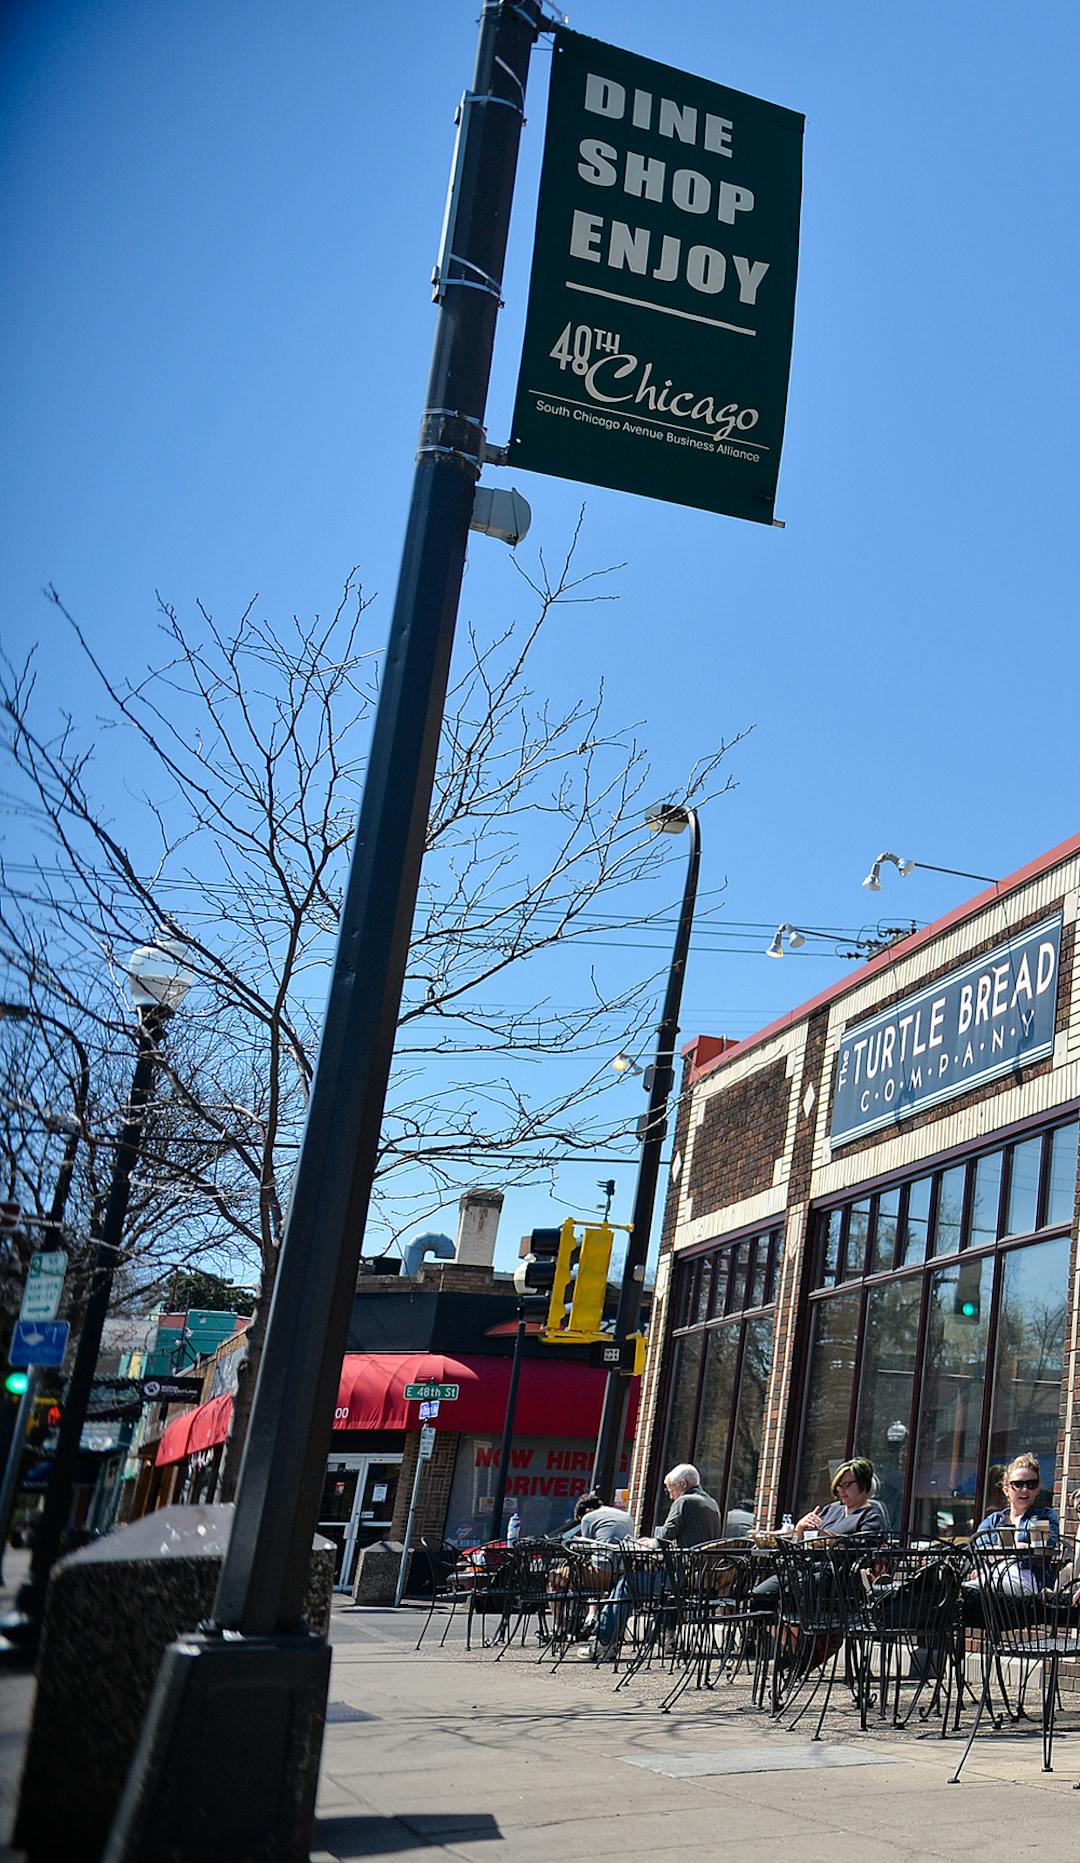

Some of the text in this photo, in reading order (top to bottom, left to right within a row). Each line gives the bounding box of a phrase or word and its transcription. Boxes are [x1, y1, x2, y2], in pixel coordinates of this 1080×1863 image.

[584, 72, 733, 159] DINE
[577, 138, 755, 225] SHOP
[568, 209, 770, 306] ENJOY
[535, 400, 761, 463] South Chicago Avenue Business Alliance
[584, 353, 760, 441] Chicago
[854, 942, 1055, 1085] TURTLE BREAD
[406, 1387, 456, 1397] E 48th St
[504, 1475, 593, 1497] RIVER
